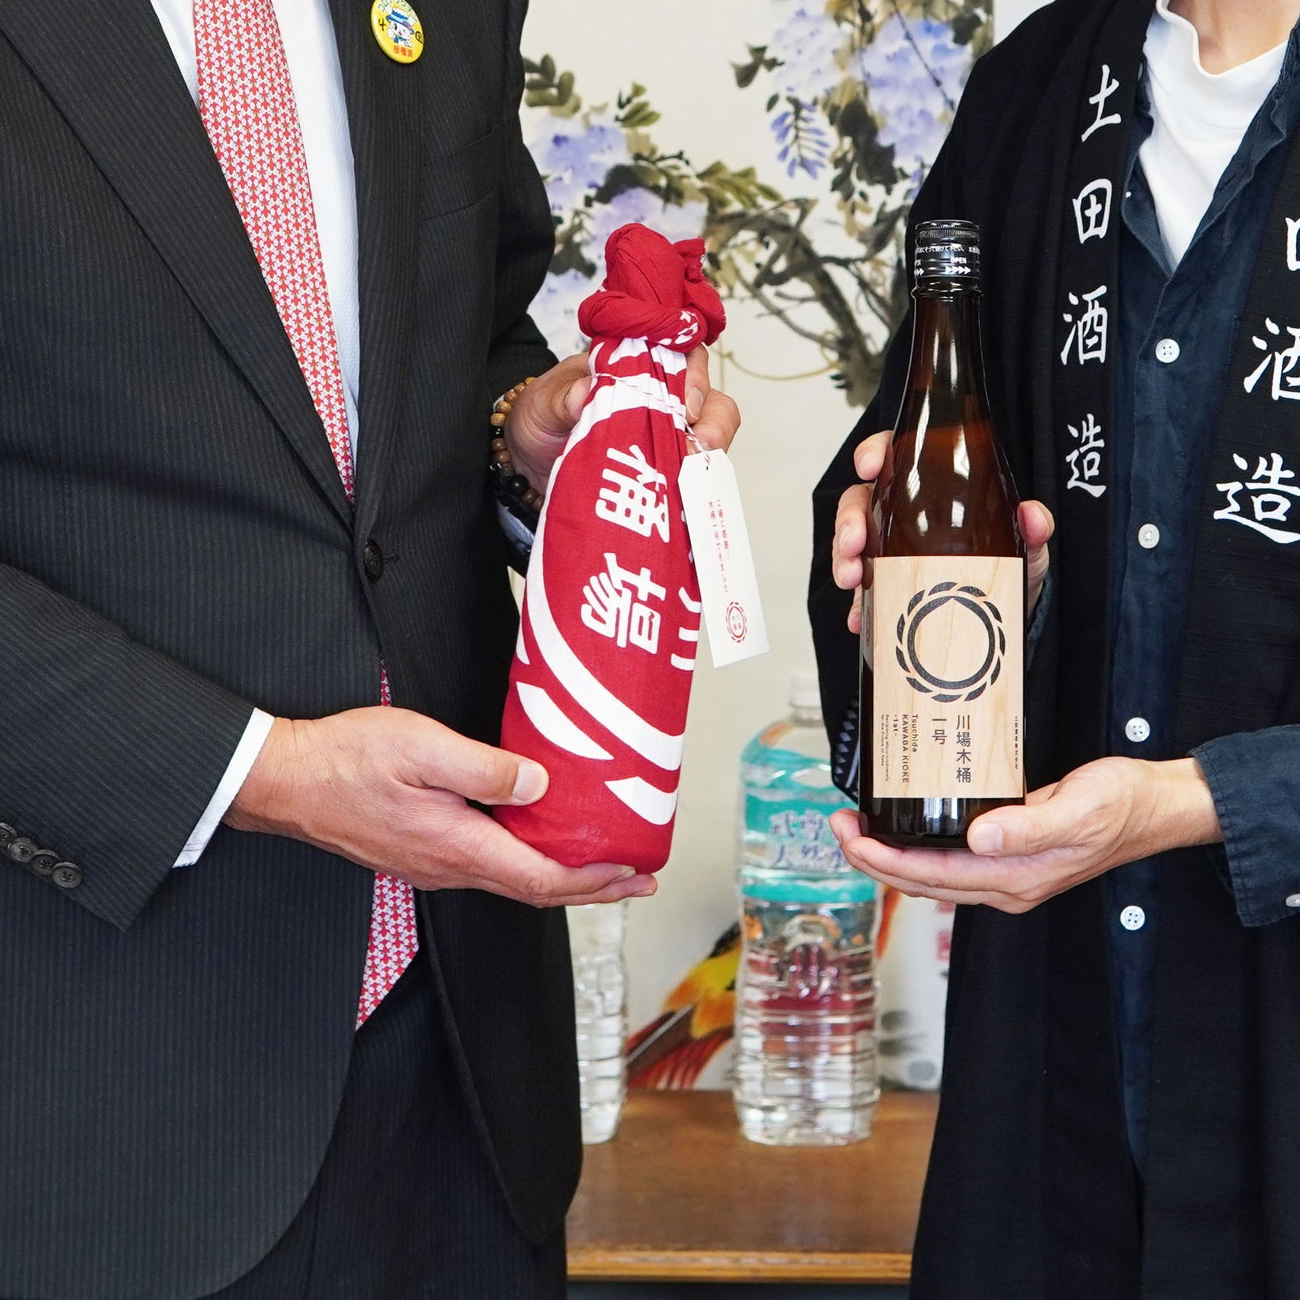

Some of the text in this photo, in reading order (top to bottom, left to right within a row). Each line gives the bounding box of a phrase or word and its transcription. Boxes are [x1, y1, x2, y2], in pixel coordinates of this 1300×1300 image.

[1060, 64, 1122, 498] 土田酒造
[901, 714, 909, 784] KAWABA KIOKE
[911, 713, 919, 753] Tsuchida
[931, 718, 948, 745] 一号
[956, 714, 972, 783] 川場木桶
